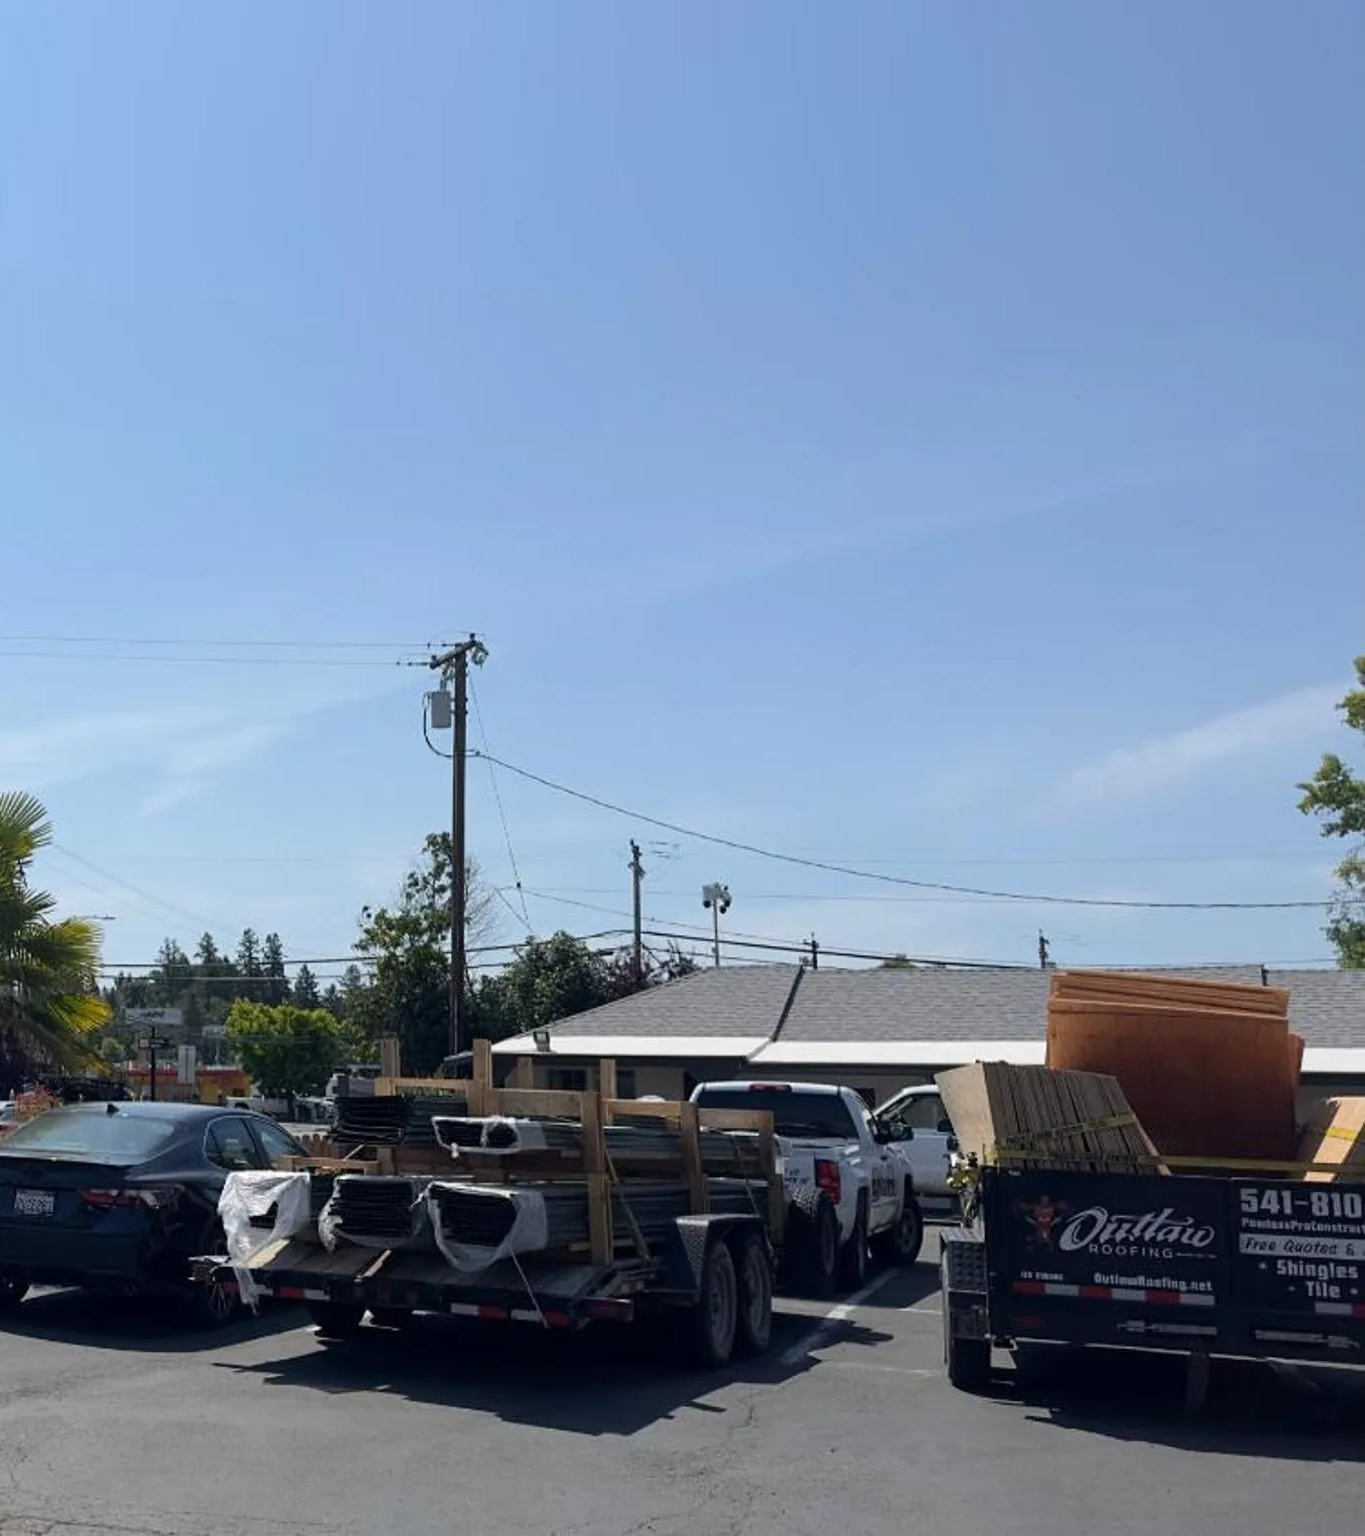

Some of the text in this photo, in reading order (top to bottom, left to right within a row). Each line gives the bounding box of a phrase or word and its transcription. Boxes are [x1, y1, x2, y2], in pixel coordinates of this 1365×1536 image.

[1240, 1188, 1362, 1218] 541-810
[1059, 1206, 1215, 1251] Outlaw
[1089, 1243, 1174, 1259] ROOFING
[1245, 1238, 1276, 1253] Free
[1284, 1240, 1337, 1256] Quotes
[1276, 1259, 1358, 1280] Shingles
[1093, 1272, 1213, 1292] OutlawRoofing.net
[1304, 1281, 1341, 1298] Tile
